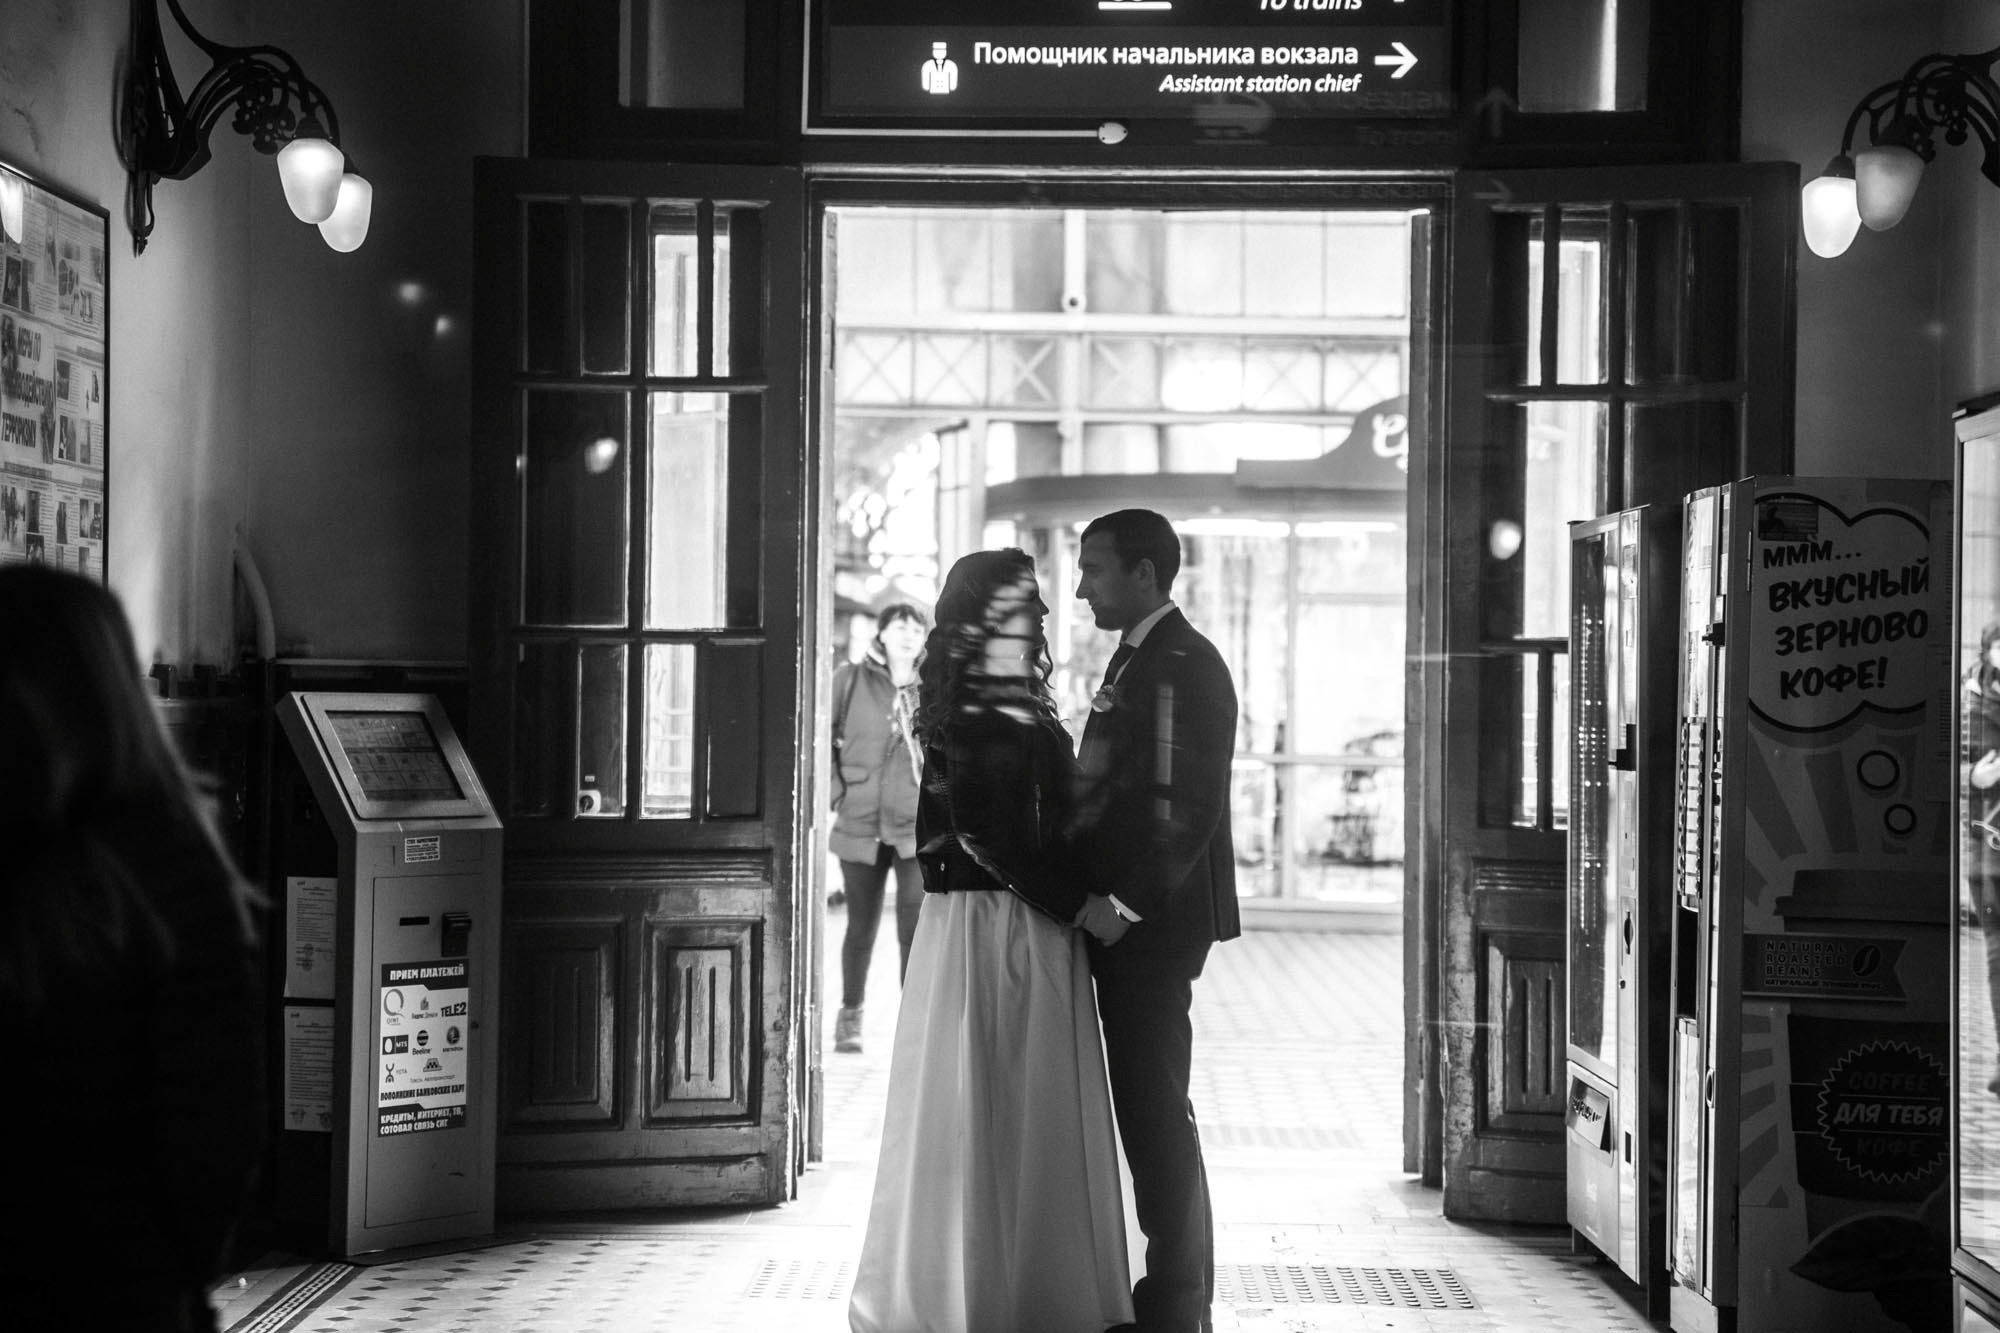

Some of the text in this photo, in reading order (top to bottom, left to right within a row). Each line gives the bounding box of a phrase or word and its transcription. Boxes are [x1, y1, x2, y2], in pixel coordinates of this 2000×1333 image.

[1293, 0, 1363, 11] trains
[974, 42, 1359, 67] Помощник начальника вокзала
[1159, 73, 1362, 93] Assistant station chief
[1769, 556, 1929, 613] ВКУСНЫЙ
[1780, 656, 1889, 700] КОФЕ!
[1765, 941, 1848, 953] NATURAL
[1765, 953, 1848, 966] ROASTED
[389, 963, 464, 981] ПРИЕМ ПЛАТЕЖЕЙ
[1765, 965, 1821, 977] BEANS
[441, 1002, 467, 1017] TELE2
[1848, 1071, 1931, 1092] COFFEE
[380, 1112, 416, 1124] КРЕДИТЫ,
[1833, 1101, 1945, 1127] ДЛЯ ТЕБЯ
[380, 1123, 412, 1135] СОТОВАЯ
[413, 1121, 434, 1131] СВЯЗЬ
[1856, 1137, 1922, 1158] КОФЕ
